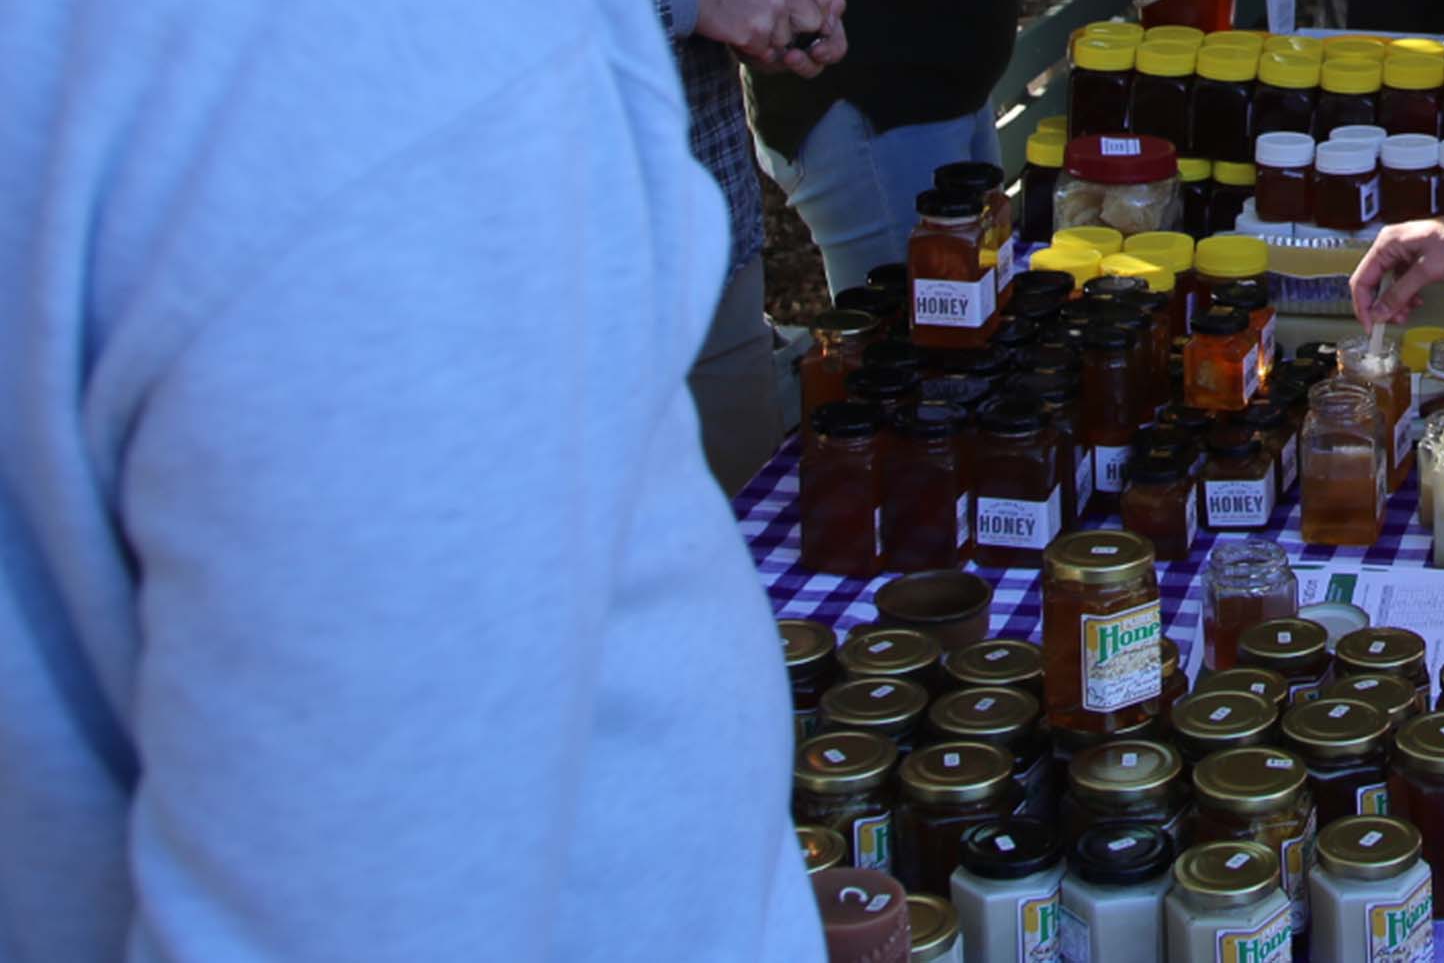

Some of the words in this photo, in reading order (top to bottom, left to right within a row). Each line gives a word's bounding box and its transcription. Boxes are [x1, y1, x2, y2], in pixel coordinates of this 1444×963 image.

[916, 296, 969, 317] HONEY
[1209, 495, 1264, 513] HONEY
[979, 515, 1036, 537] HONEY
[1096, 620, 1160, 664] Hone
[1387, 897, 1432, 946] Hone
[1238, 924, 1292, 963] Hone
